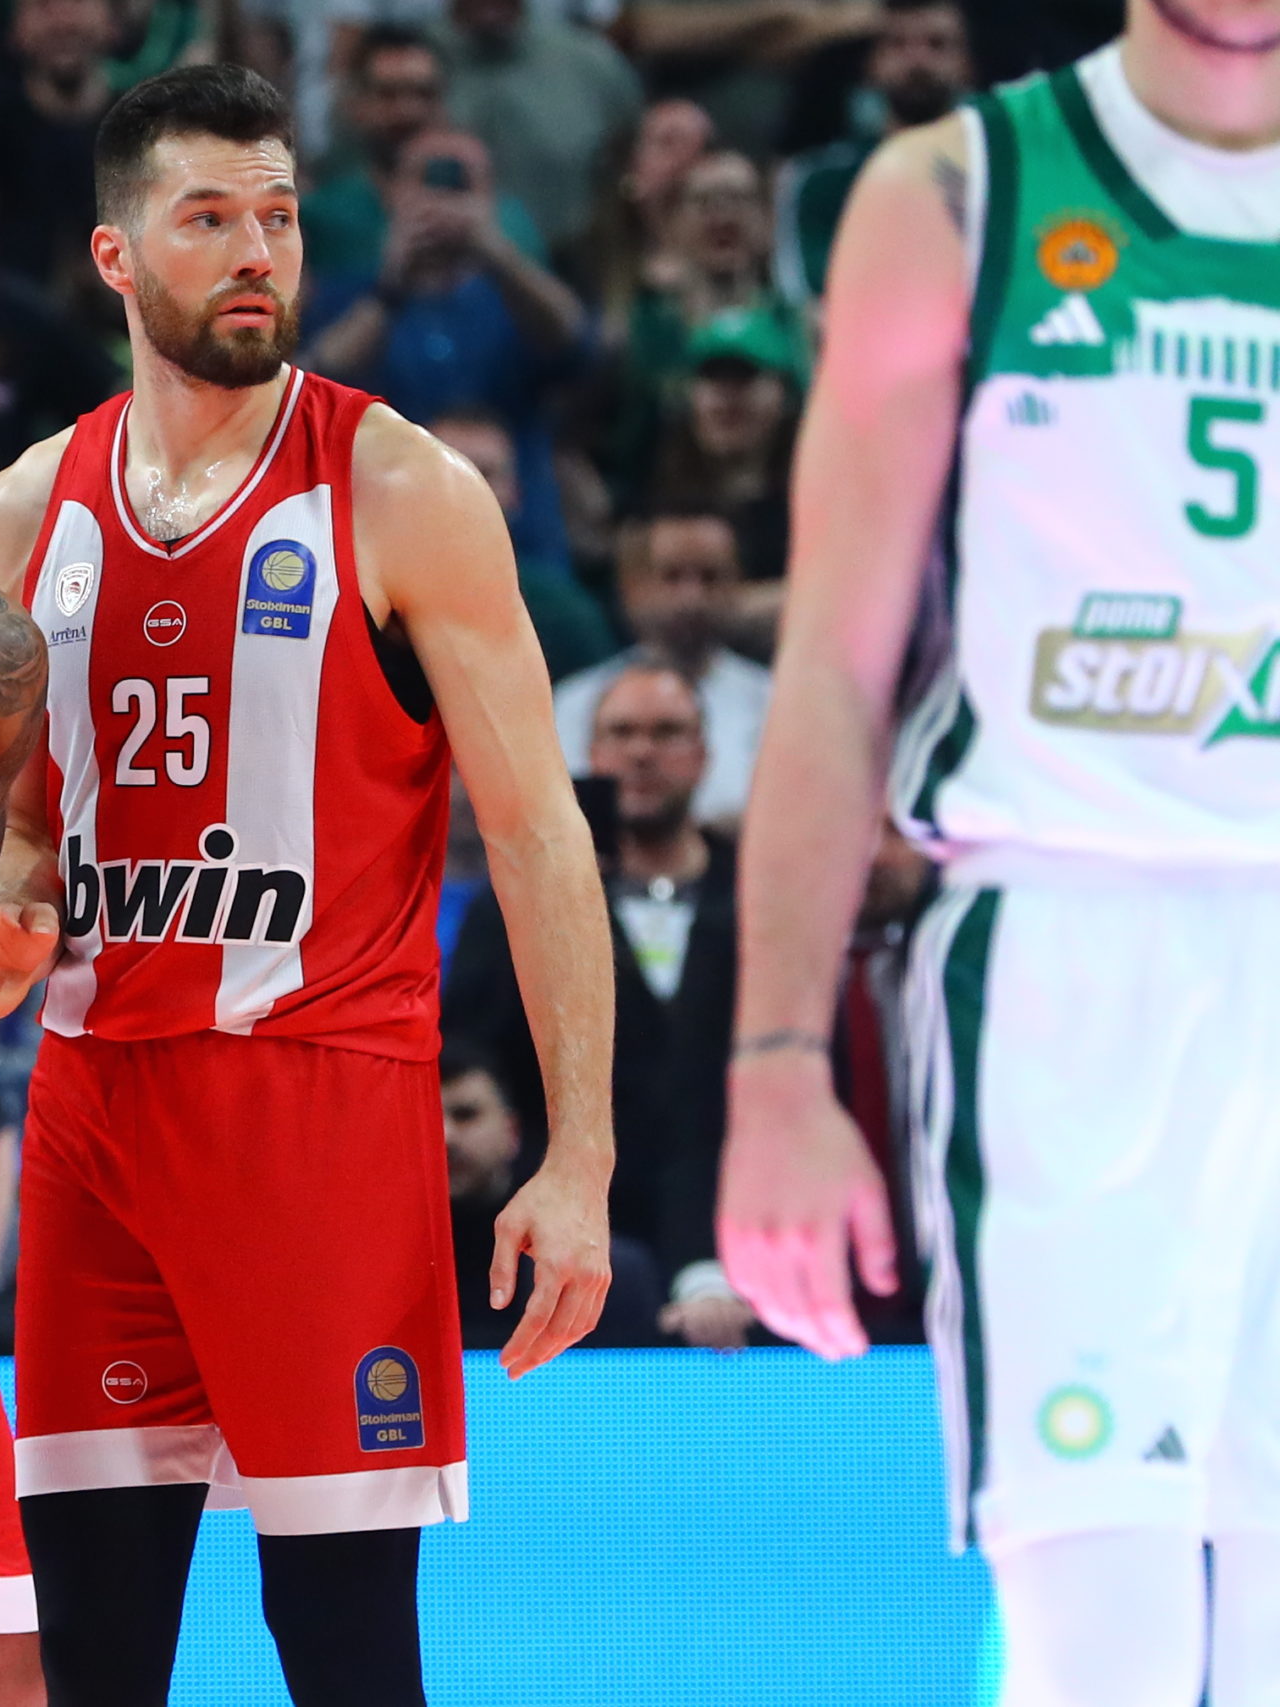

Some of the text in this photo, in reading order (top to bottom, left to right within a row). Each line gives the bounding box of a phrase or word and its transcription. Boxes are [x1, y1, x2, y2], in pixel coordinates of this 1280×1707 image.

[1183, 393, 1266, 540] 5
[246, 599, 311, 615] Stoiximan
[147, 617, 183, 628] GSA
[260, 616, 292, 630] GBL
[111, 675, 211, 787] 25
[66, 823, 313, 947] bwin
[105, 1377, 144, 1387] GSA
[359, 1412, 421, 1426] Stoiximan
[376, 1428, 408, 1442] GBL
